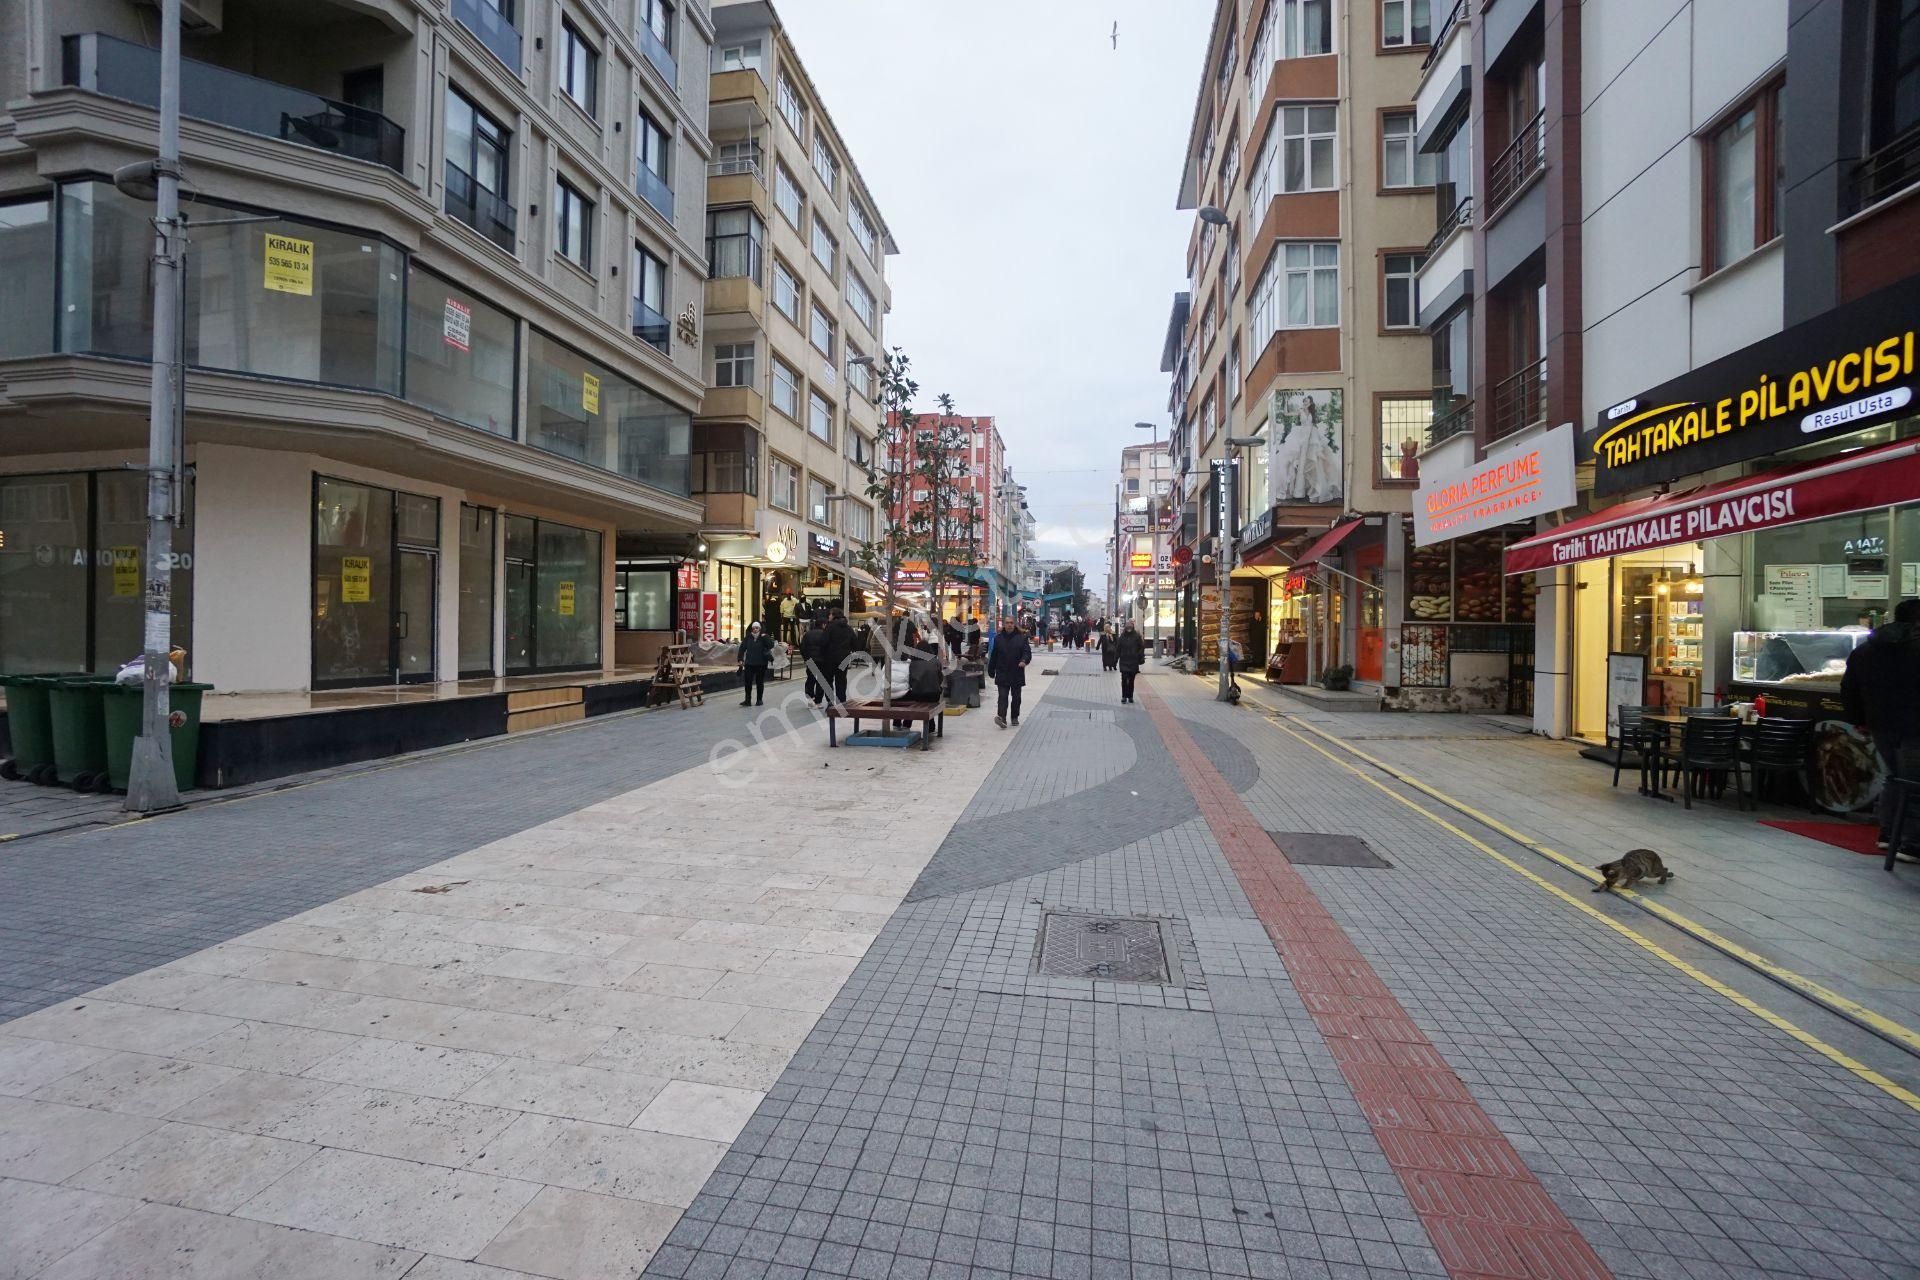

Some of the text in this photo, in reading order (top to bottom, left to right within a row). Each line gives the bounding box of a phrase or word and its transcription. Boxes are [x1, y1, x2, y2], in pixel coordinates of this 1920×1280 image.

[1604, 331, 1914, 469] TAHTAKALE PİLAVCISI
[1613, 402, 1632, 416] Tarihi
[1814, 395, 1893, 428] Resul Usta
[1426, 450, 1543, 513] GLORIA PERFUME
[1552, 487, 1796, 562] Tarihi TAHTAKALE PİLAVCISI
